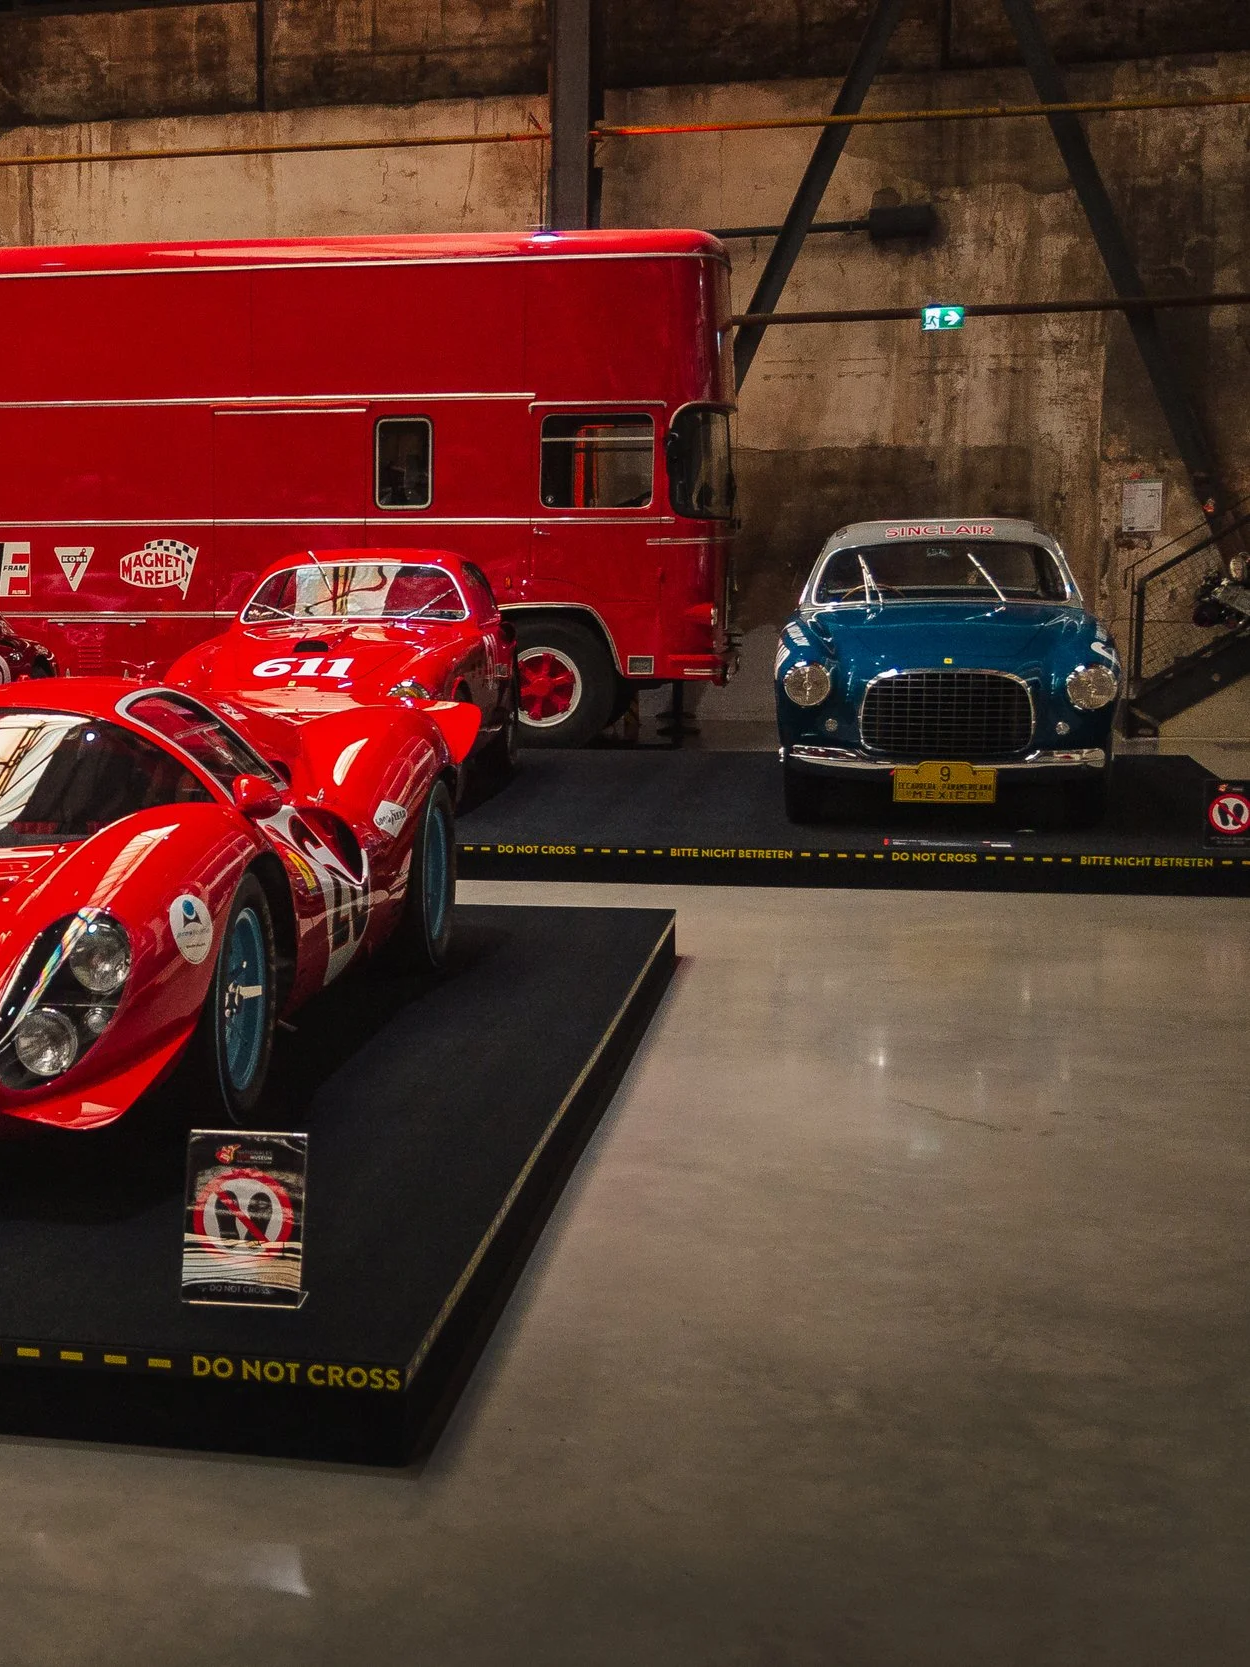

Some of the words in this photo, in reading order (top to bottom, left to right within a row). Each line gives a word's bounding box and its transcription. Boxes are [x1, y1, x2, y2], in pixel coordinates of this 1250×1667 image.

[885, 524, 994, 538] SINCLAIR
[122, 553, 185, 574] MAGNETI
[122, 563, 185, 585] MARELLI
[251, 657, 355, 678] 611
[939, 765, 951, 782] 9
[497, 844, 514, 853] DO
[517, 845, 538, 854] NOT
[541, 846, 576, 855] CROSS
[670, 848, 699, 857] BITTE
[701, 849, 736, 858] NICHT
[738, 850, 793, 859] BETRETEN
[891, 852, 909, 861] DO
[912, 853, 936, 862] NOT
[939, 853, 977, 863] CROSS
[1080, 856, 1111, 865] BITTE
[1114, 857, 1151, 866] NICHT
[1154, 857, 1214, 867] BETRETEN
[192, 1355, 235, 1378] DO
[242, 1359, 300, 1384] NOT
[307, 1364, 401, 1391] CROSS
